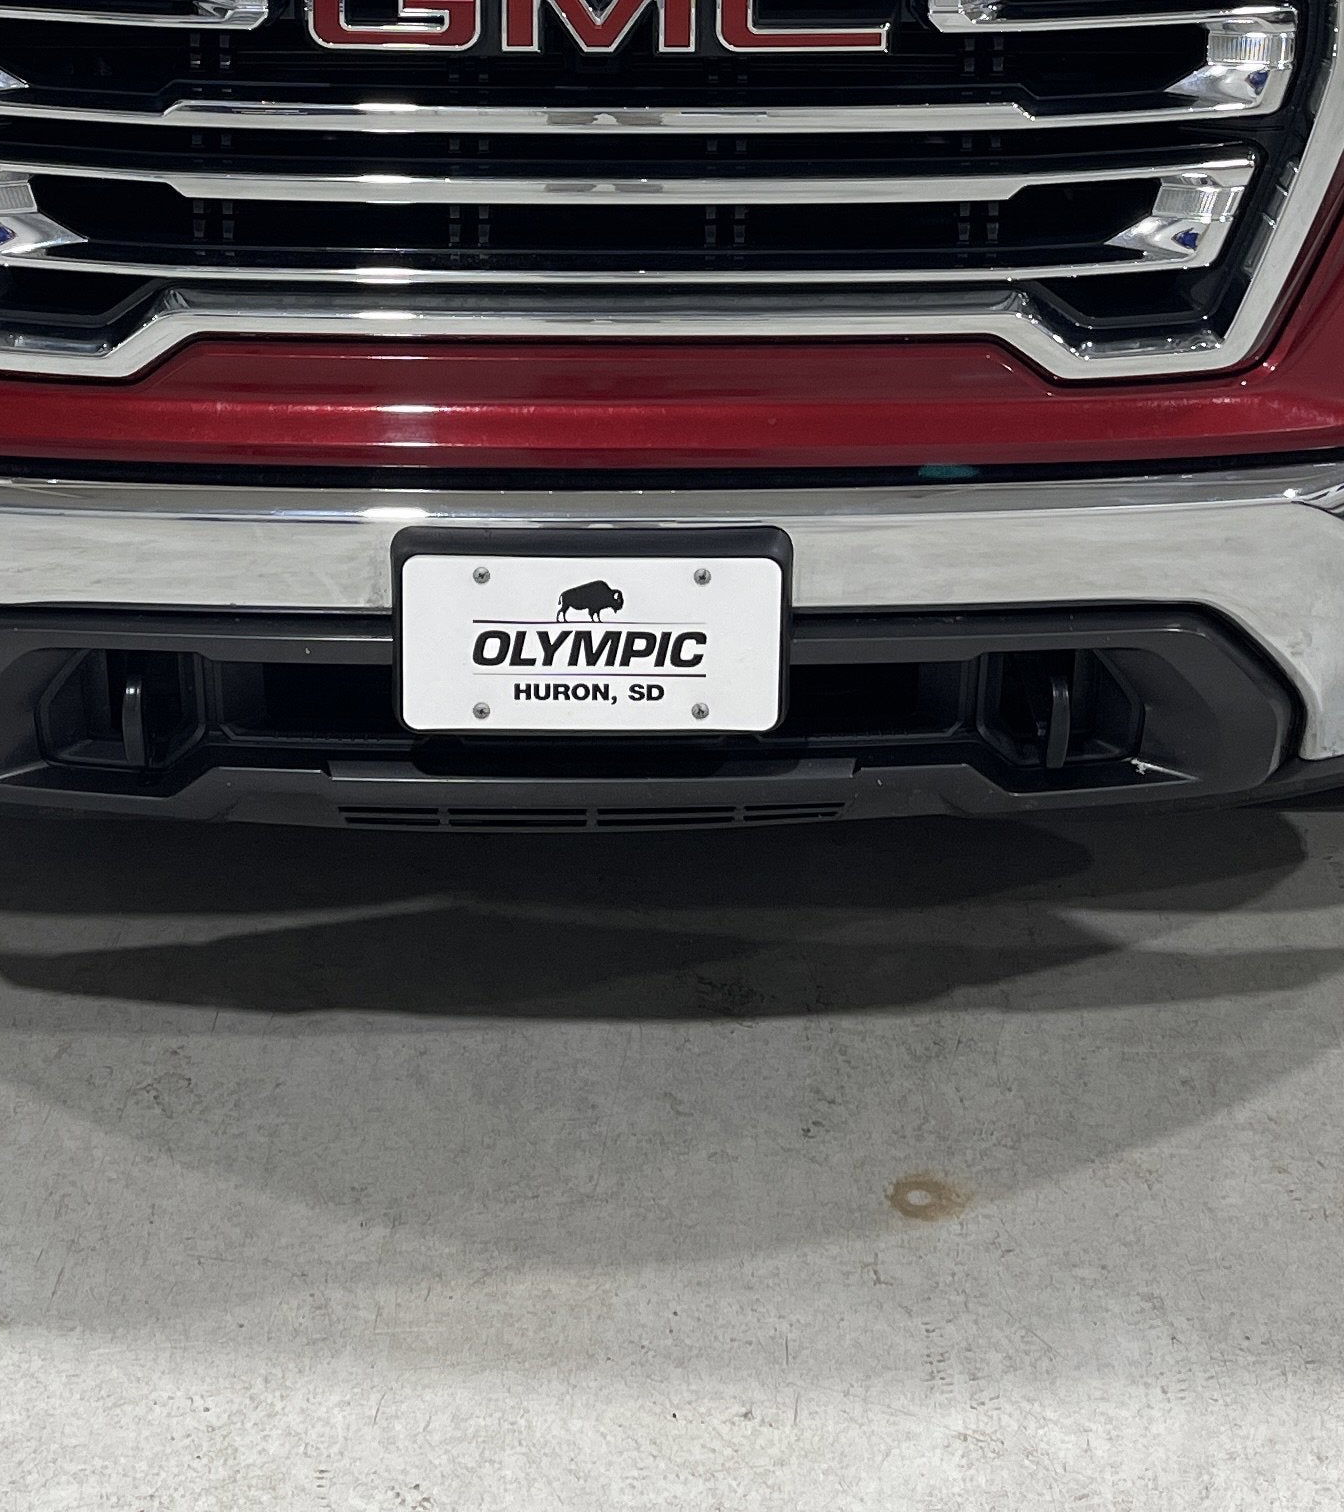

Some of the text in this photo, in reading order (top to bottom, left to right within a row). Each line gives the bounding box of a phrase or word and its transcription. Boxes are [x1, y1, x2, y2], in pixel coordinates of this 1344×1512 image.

[472, 630, 707, 668] OLYMPIC
[513, 683, 665, 705] HURON, SD
